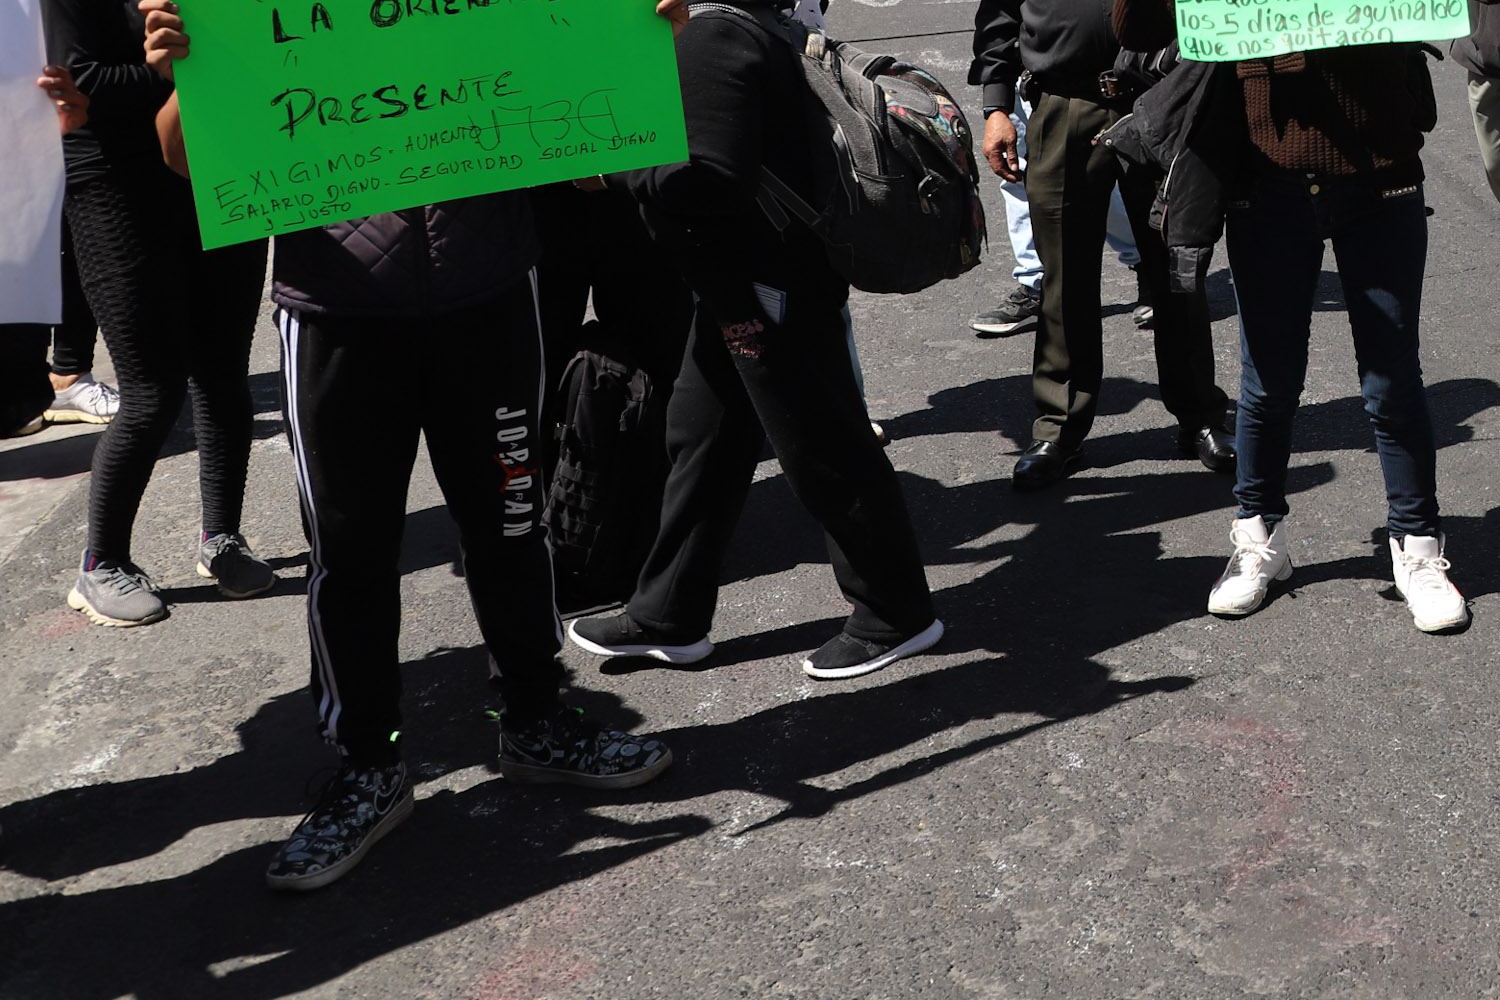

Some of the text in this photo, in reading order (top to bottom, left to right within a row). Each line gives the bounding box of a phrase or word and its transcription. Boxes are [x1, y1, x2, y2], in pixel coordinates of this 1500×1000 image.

[1180, 8, 1215, 30] los
[1216, 12, 1239, 36] 5
[1307, 2, 1334, 28] de
[1184, 35, 1229, 58] que
[1237, 38, 1275, 55] nos
[270, 70, 522, 142] PRESENTE
[220, 193, 314, 225] SALARIO
[397, 154, 523, 185] SEGURIDAD
[539, 141, 599, 160] SOCIAL
[607, 130, 657, 150] DIGNO
[283, 202, 352, 227] JUSTO
[495, 406, 534, 537] JORDAN
